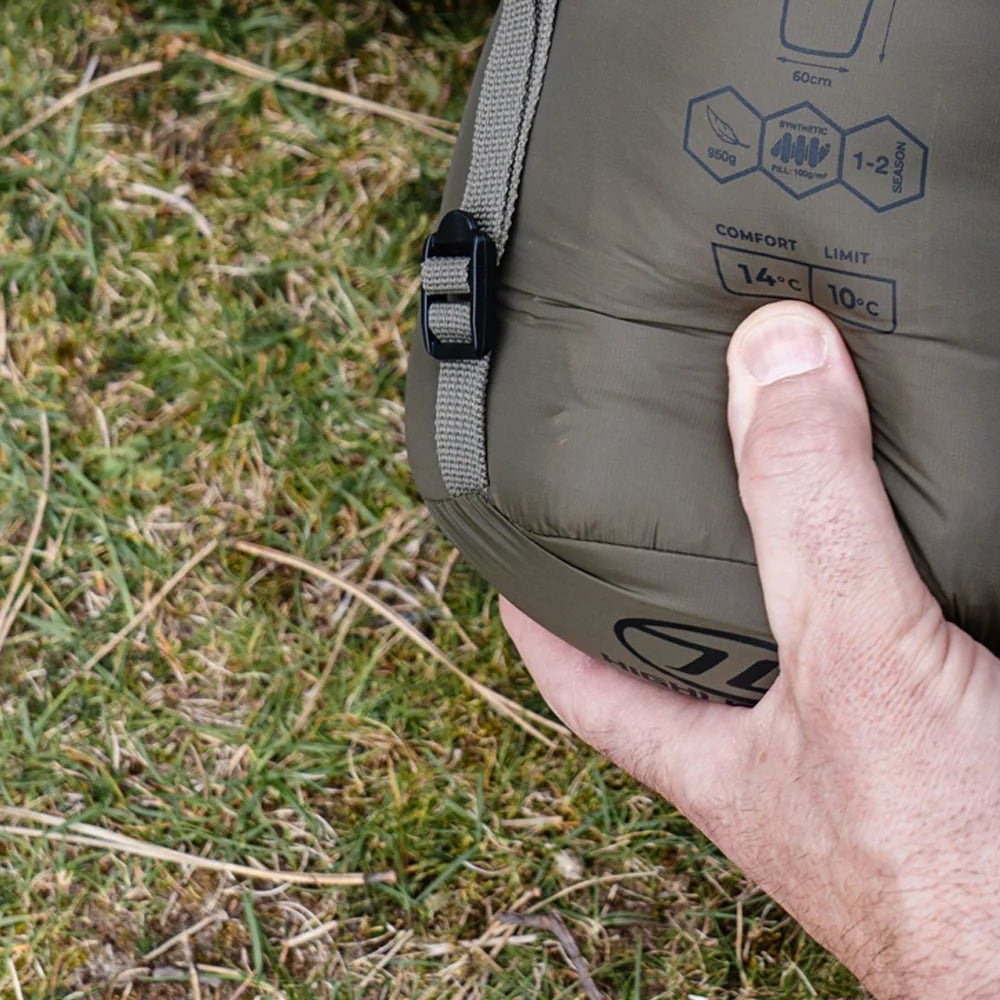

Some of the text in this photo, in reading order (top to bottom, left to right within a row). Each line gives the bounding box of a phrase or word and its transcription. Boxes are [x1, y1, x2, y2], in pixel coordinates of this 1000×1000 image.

[792, 70, 832, 88] 60cm
[853, 151, 889, 175] 1-2
[892, 141, 906, 194] SEASON
[715, 223, 798, 251] COMFORT
[824, 246, 870, 265] LIMIT
